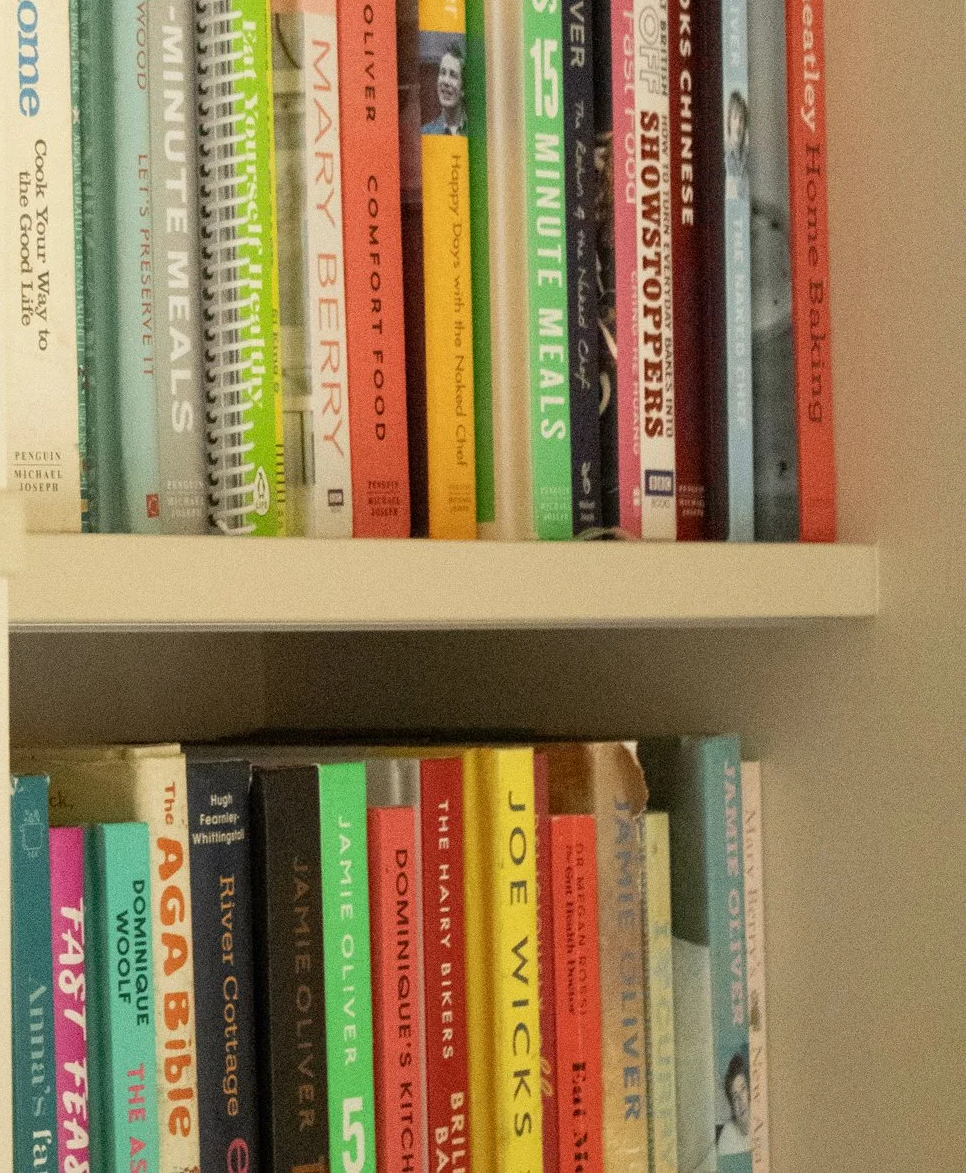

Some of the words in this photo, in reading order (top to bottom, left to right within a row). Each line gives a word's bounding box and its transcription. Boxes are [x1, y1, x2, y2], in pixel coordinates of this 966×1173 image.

[136, 1, 148, 91] WOOD
[241, 20, 258, 81] Eat
[363, 4, 377, 122] OLIVER
[530, 37, 560, 120] 15
[639, 6, 661, 96] OFF
[659, 19, 668, 98] BRITISH
[35, 138, 48, 197] Cook
[242, 92, 263, 256] Yourself
[312, 39, 336, 227] MARY
[661, 114, 669, 155] HOW
[661, 163, 669, 188] TO
[679, 69, 694, 227] CHINESE
[19, 169, 32, 207] the
[138, 154, 151, 218] LET'S
[449, 152, 463, 214] Happy
[534, 131, 564, 289] MINUTE
[662, 197, 670, 235] TURN
[805, 141, 824, 269] Home
[19, 213, 33, 274] Good
[35, 205, 49, 264] Your
[368, 174, 383, 335] COMFORT
[450, 221, 464, 269] Days
[639, 110, 664, 439] SHOWSTOPPERS
[20, 281, 35, 327] Life
[35, 269, 50, 324] Way
[140, 228, 153, 346] PRESERVE
[454, 274, 466, 314] with
[663, 241, 673, 328] EVERYDAY
[37, 329, 49, 352] to
[166, 250, 194, 435] MEALS
[247, 263, 267, 409] Healthy
[317, 252, 345, 458] BERRY
[454, 321, 466, 348] the
[538, 306, 567, 441] MEALS
[665, 337, 673, 389] BAKES
[808, 279, 827, 425] Baking
[372, 349, 387, 442] FOOD
[455, 354, 467, 418] Naked
[665, 396, 674, 439] INTO
[14, 470, 63, 479] MICHAEL
[15, 452, 61, 461] PENGUIN
[18, 482, 59, 492] JOSEPH
[455, 424, 469, 468] Chef
[164, 782, 177, 826] The
[210, 794, 234, 808] Hugh
[437, 799, 451, 851] THE
[723, 761, 740, 876] JAMIE
[338, 816, 354, 921] JAMIE
[508, 790, 529, 906] JOE
[613, 798, 636, 930] JAMIE
[156, 836, 188, 977] AGA
[219, 874, 236, 965] River
[293, 857, 312, 974] JAMIE
[438, 863, 452, 948] HAIRY
[576, 876, 587, 948] MEGAN
[58, 896, 88, 1041] FAST
[116, 909, 132, 1005] WOOLF
[133, 879, 150, 1027] DOMINIQUE
[395, 849, 414, 1068] DOMINIQUE'S
[728, 889, 744, 1026] OLIVER
[341, 932, 359, 1066] OLIVER
[440, 962, 455, 1060] BIKERS
[511, 935, 533, 1139] WICKS
[620, 950, 642, 1122] OLIVER
[28, 976, 51, 1118] Anna's
[164, 990, 195, 1139] Bible
[222, 974, 240, 1117] Cottage
[296, 984, 316, 1132] OLIVER
[127, 1063, 146, 1124] THE
